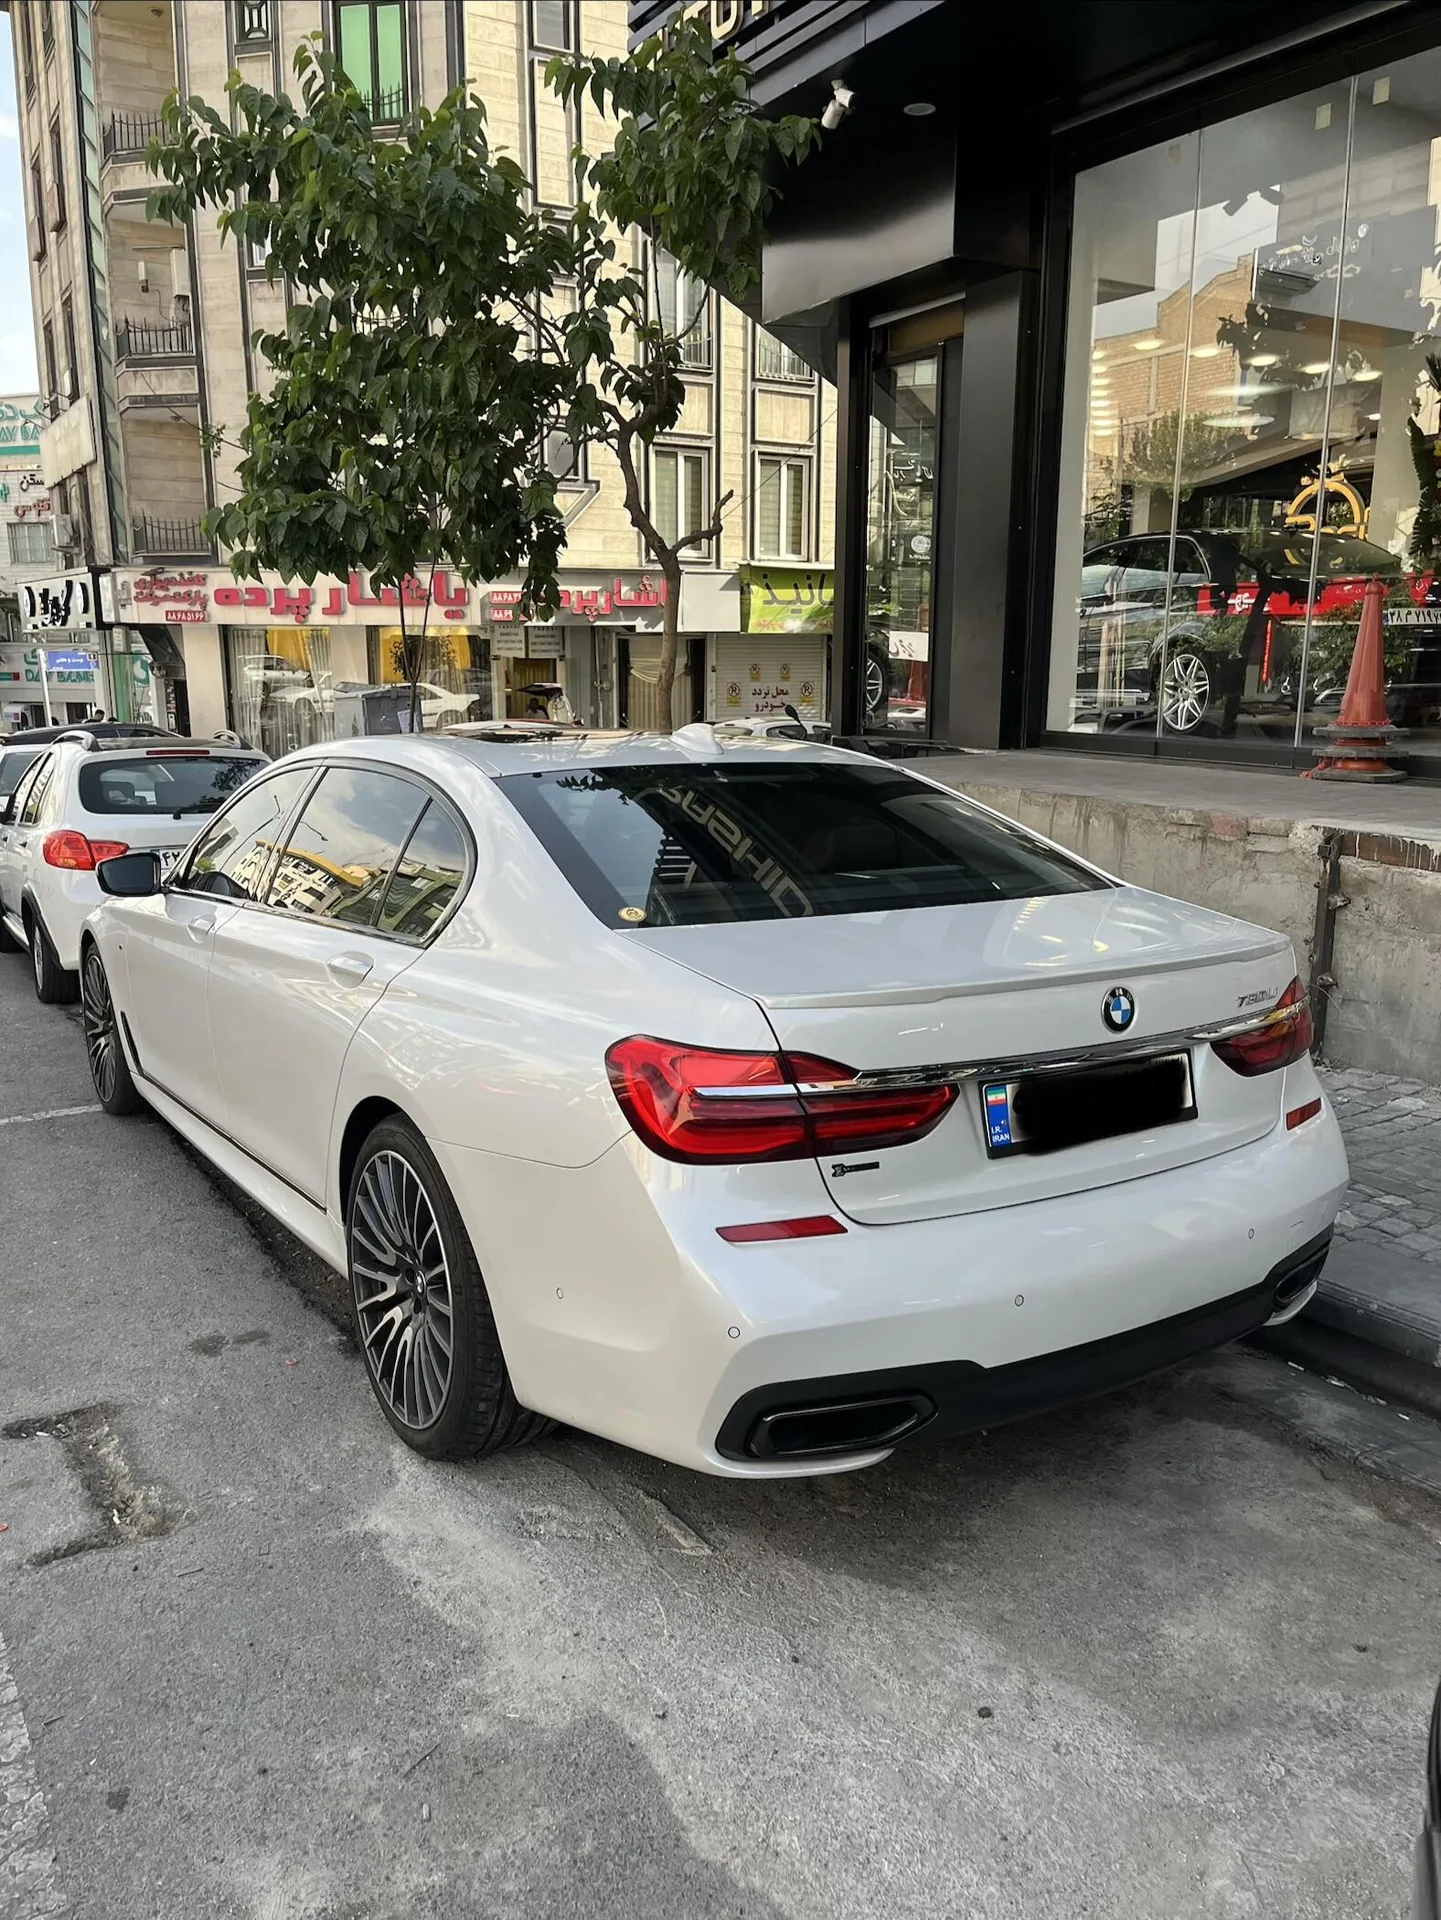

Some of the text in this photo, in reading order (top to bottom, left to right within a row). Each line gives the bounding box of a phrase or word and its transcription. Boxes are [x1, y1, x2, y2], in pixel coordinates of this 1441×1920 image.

[0, 425, 18, 441] AY
[214, 587, 311, 624] پرده
[558, 575, 667, 622] اشار پرد
[752, 686, 789, 699] محل تردد
[755, 699, 787, 712] خودرو
[992, 1133, 1010, 1143] IRAN
